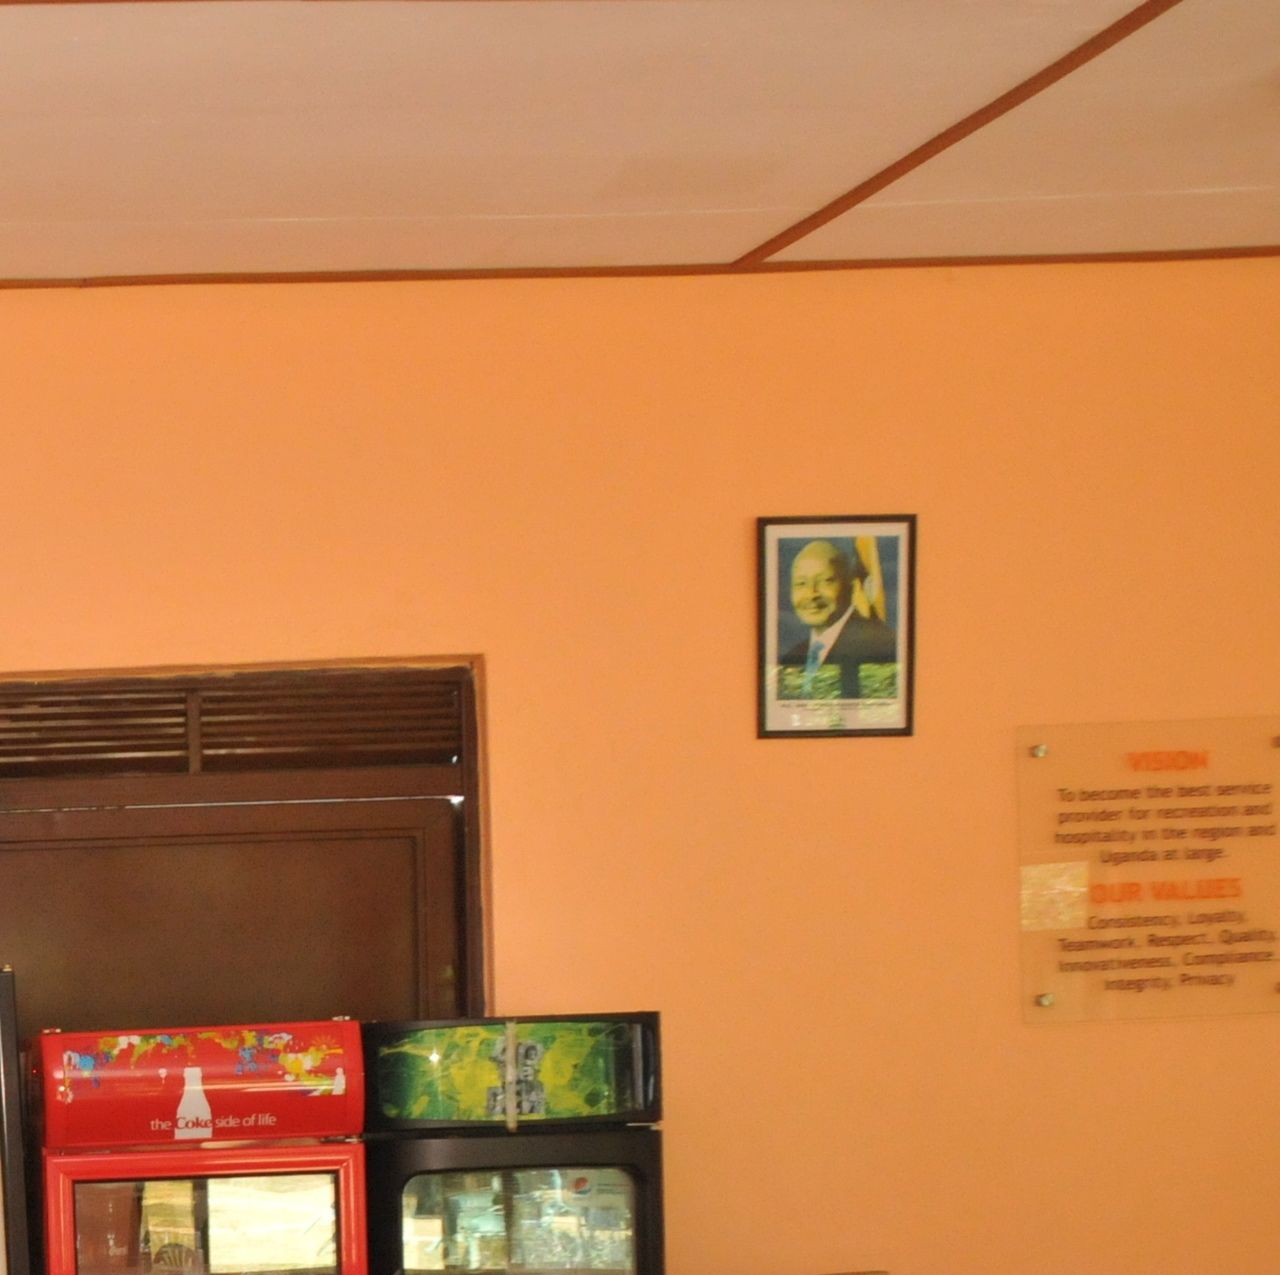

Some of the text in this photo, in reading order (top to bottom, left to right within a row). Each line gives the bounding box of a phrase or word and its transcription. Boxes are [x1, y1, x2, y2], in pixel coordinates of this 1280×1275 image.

[1057, 784, 1272, 802] To become the best service
[1058, 804, 1272, 825] provider for recreation and
[1055, 825, 1275, 844] hospitality in the region and
[1101, 850, 1158, 866] Uganda
[1163, 850, 1177, 860] at
[1090, 878, 1243, 904] OUR VALUES
[150, 1112, 277, 1130] the Coke side of life
